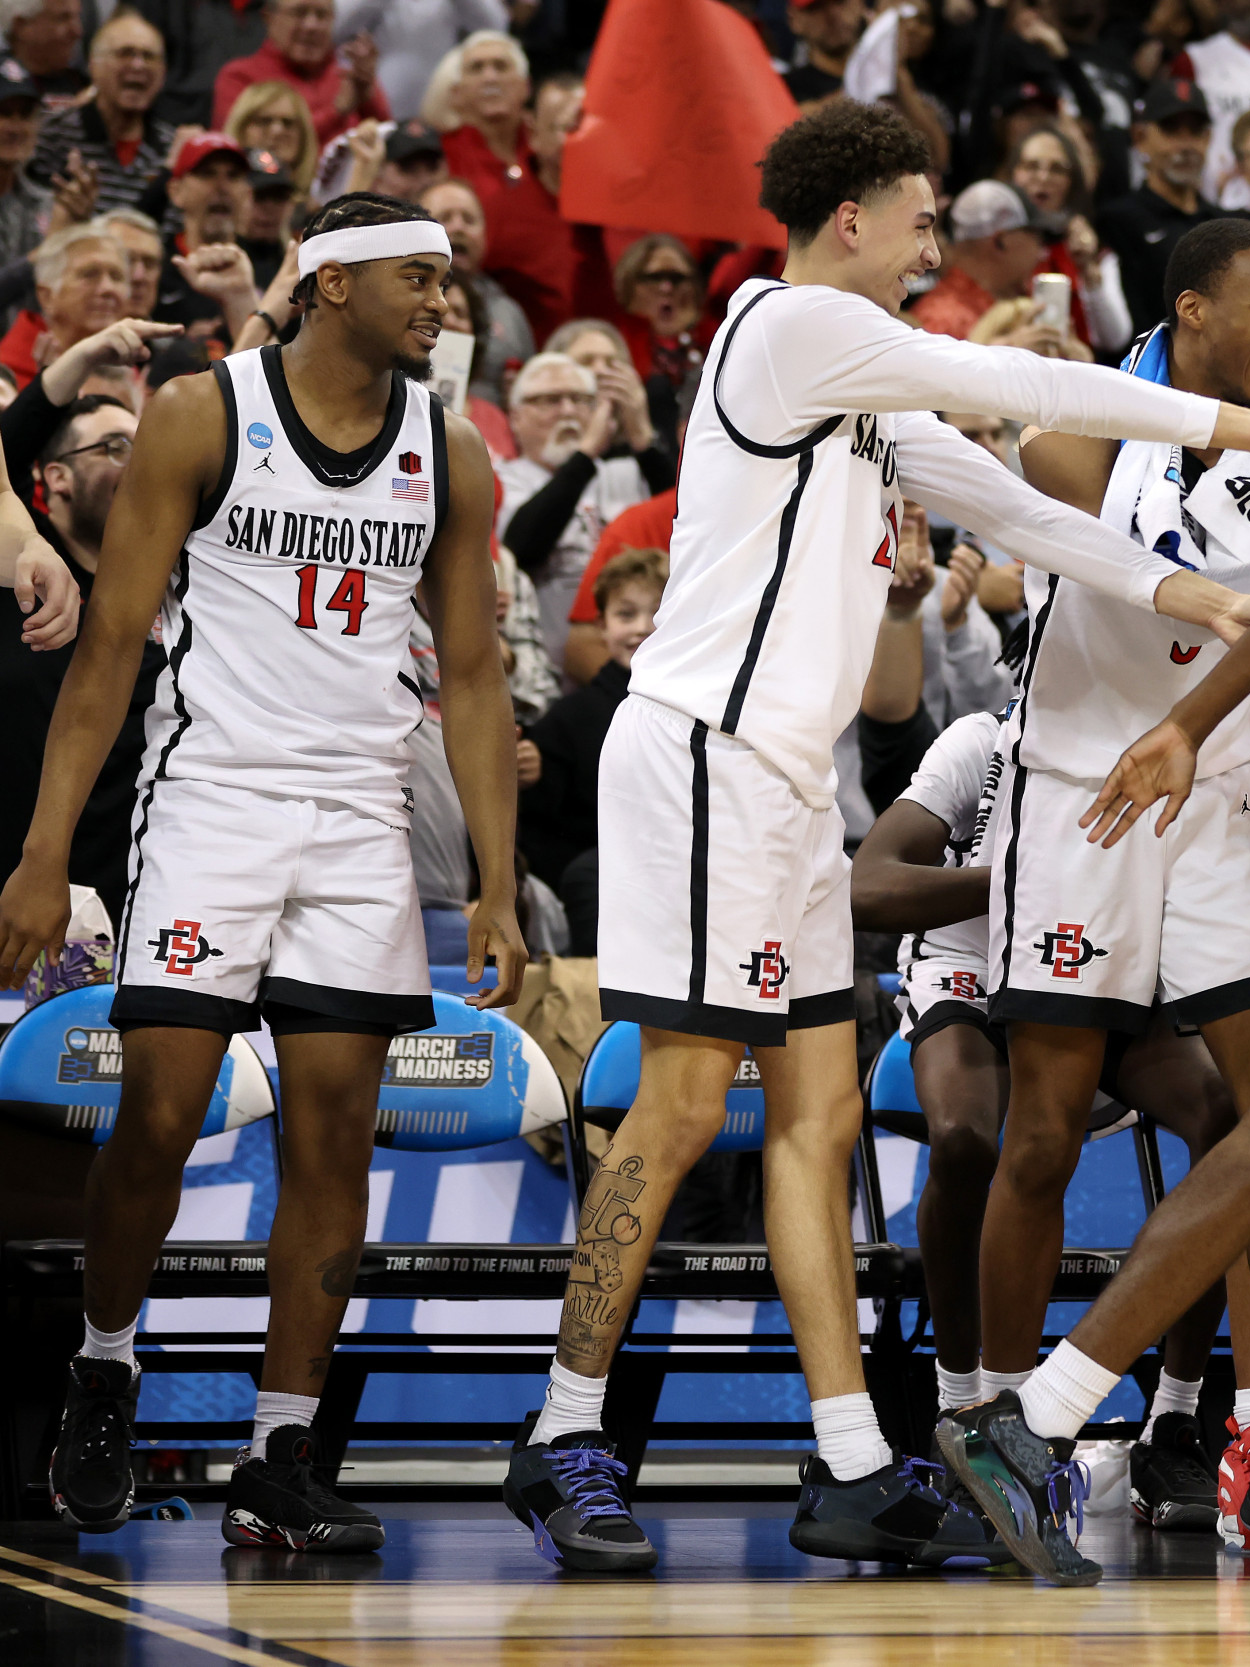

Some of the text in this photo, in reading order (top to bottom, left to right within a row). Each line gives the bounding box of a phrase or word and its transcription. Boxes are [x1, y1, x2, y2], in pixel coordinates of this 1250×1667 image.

[249, 431, 272, 446] NCAA
[224, 504, 427, 568] SAN DIEGO STATE
[294, 563, 370, 637] 14
[387, 1037, 457, 1059] MARCH
[395, 1058, 492, 1080] MADNESS
[162, 1256, 266, 1272] THE FINAL FOUR
[386, 1256, 573, 1273] THE ROAD TO THE FINAL FOUR
[684, 1257, 710, 1271] THE
[711, 1257, 747, 1271] ROAD
[749, 1257, 767, 1271] TO
[1060, 1258, 1085, 1274] THE
